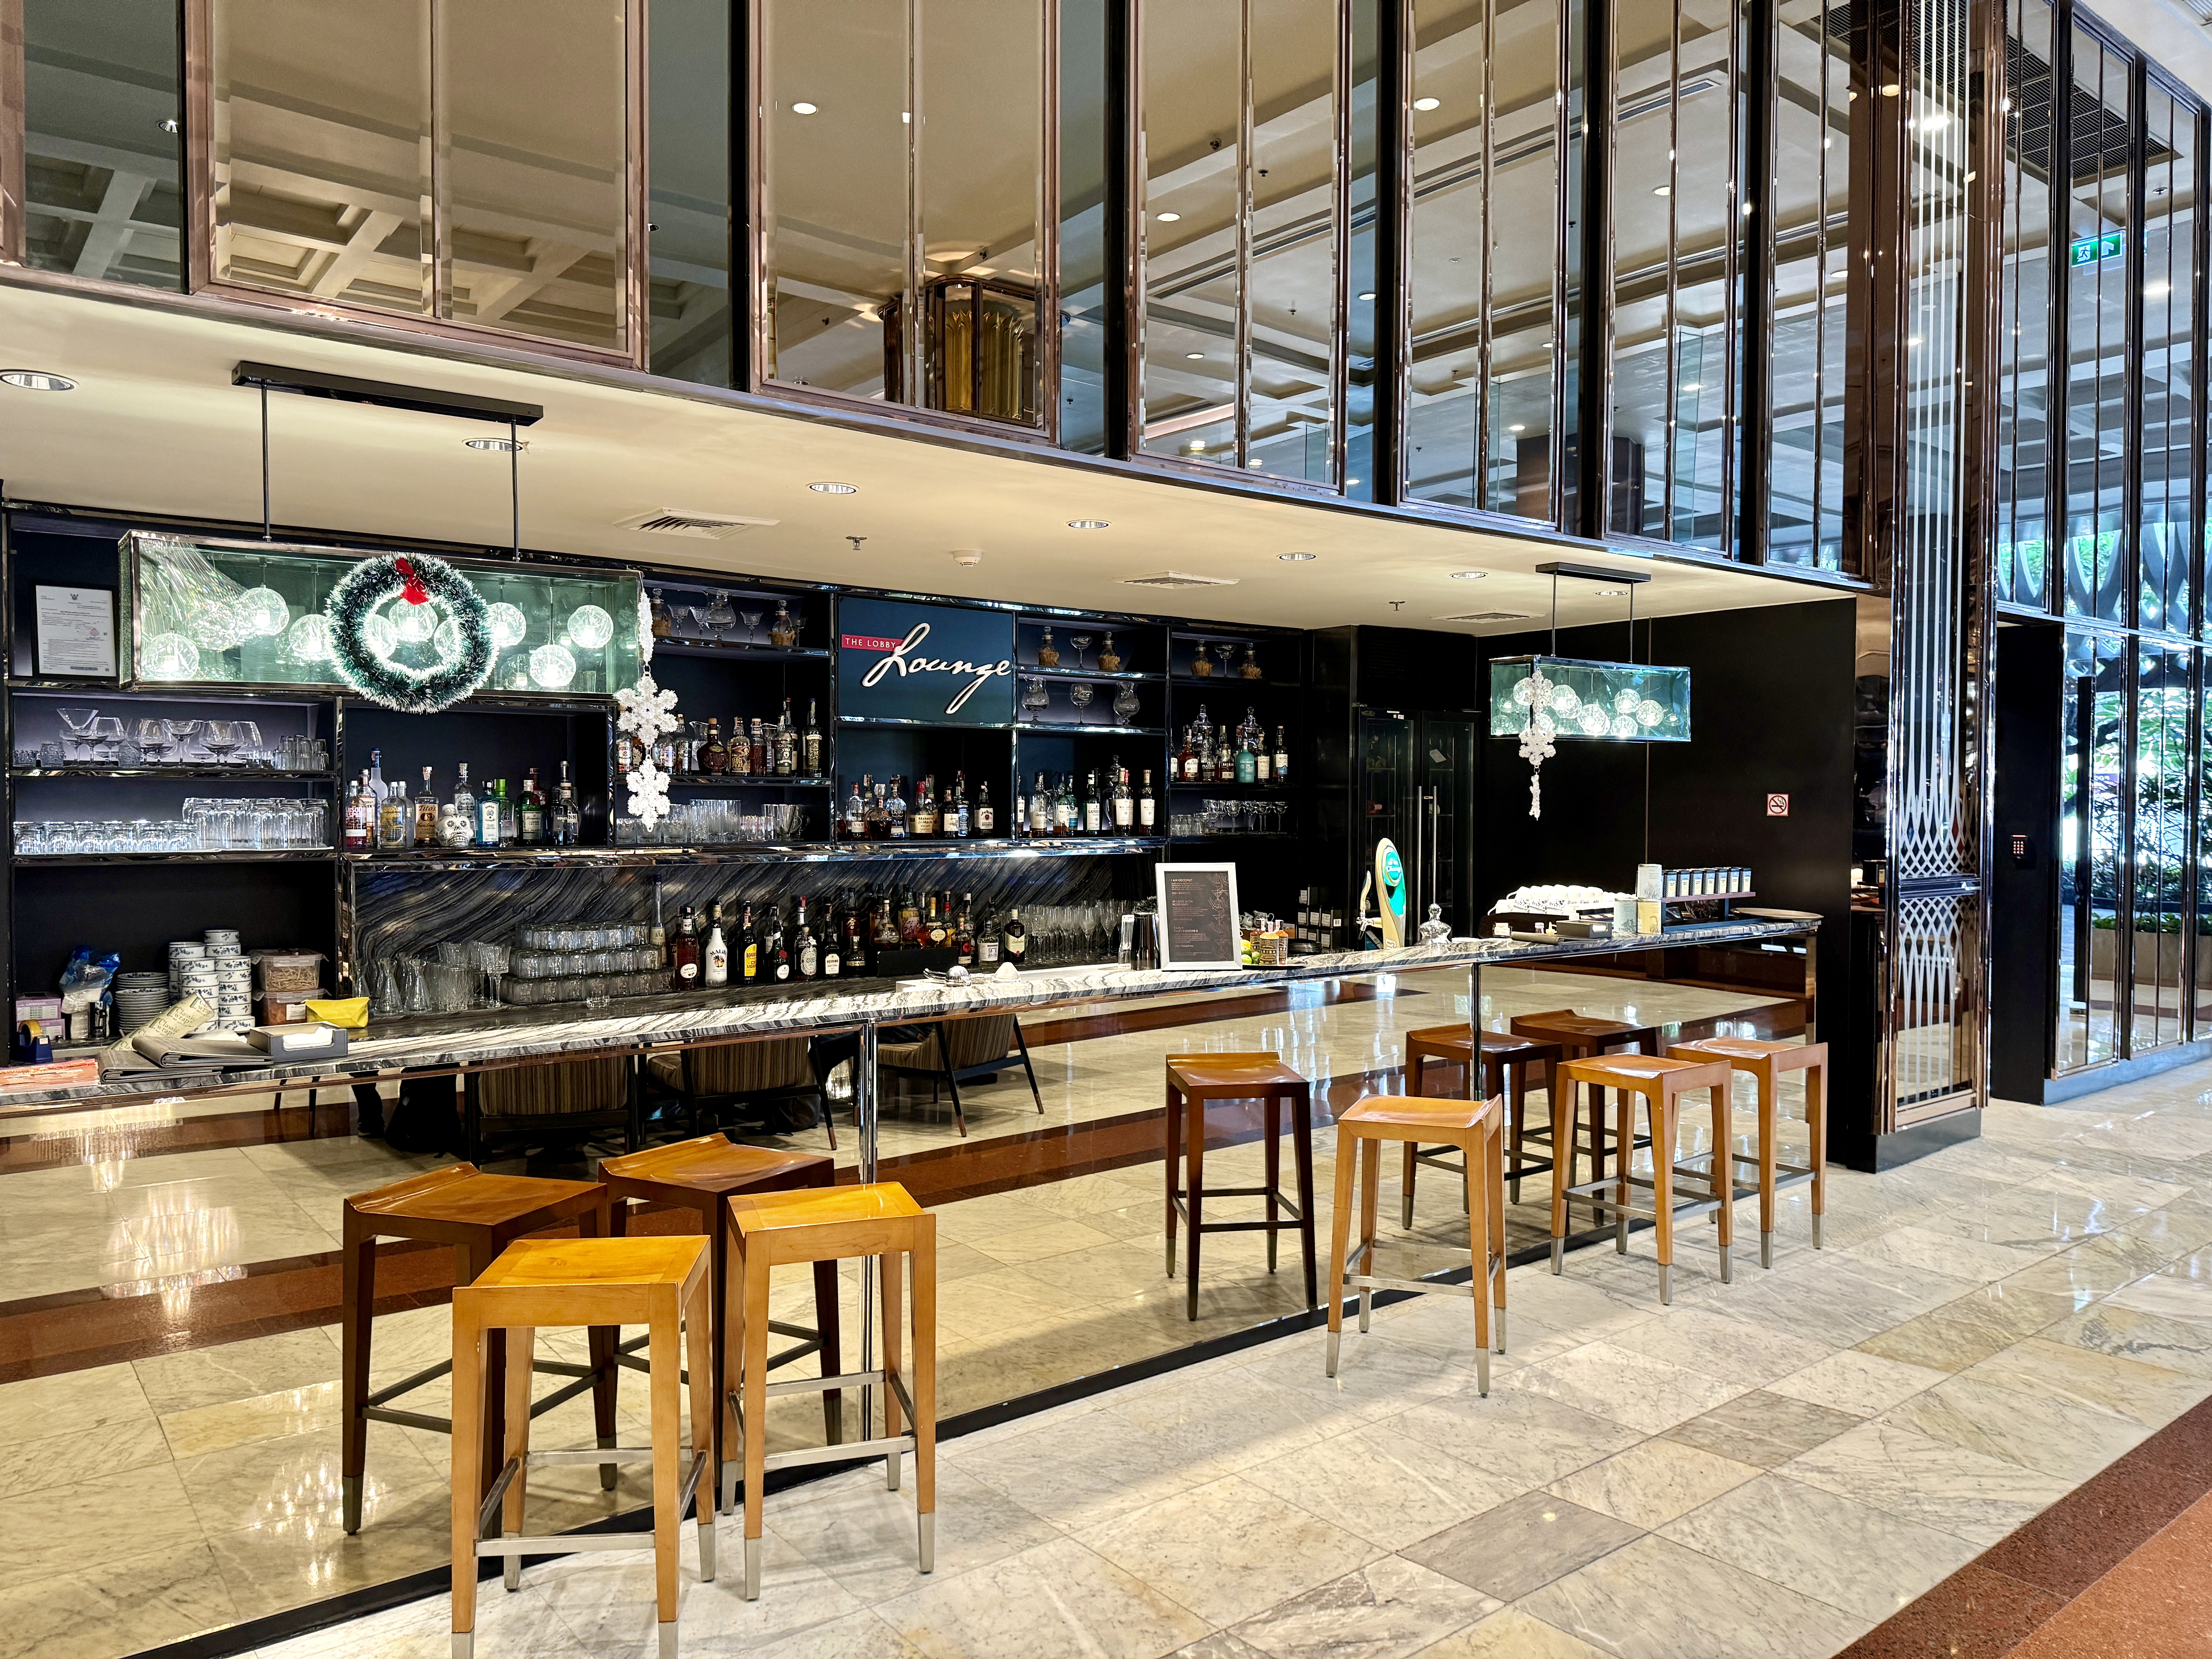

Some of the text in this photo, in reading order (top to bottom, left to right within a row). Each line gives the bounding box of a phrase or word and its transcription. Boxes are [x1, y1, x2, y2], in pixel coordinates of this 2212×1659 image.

[845, 638, 896, 649] THE LOBBY
[862, 622, 1012, 714] Lounge
[174, 1014, 191, 1024] wrap
[176, 1007, 196, 1021] Classic
[157, 1025, 173, 1036] wrap
[159, 1018, 179, 1033] Classic
